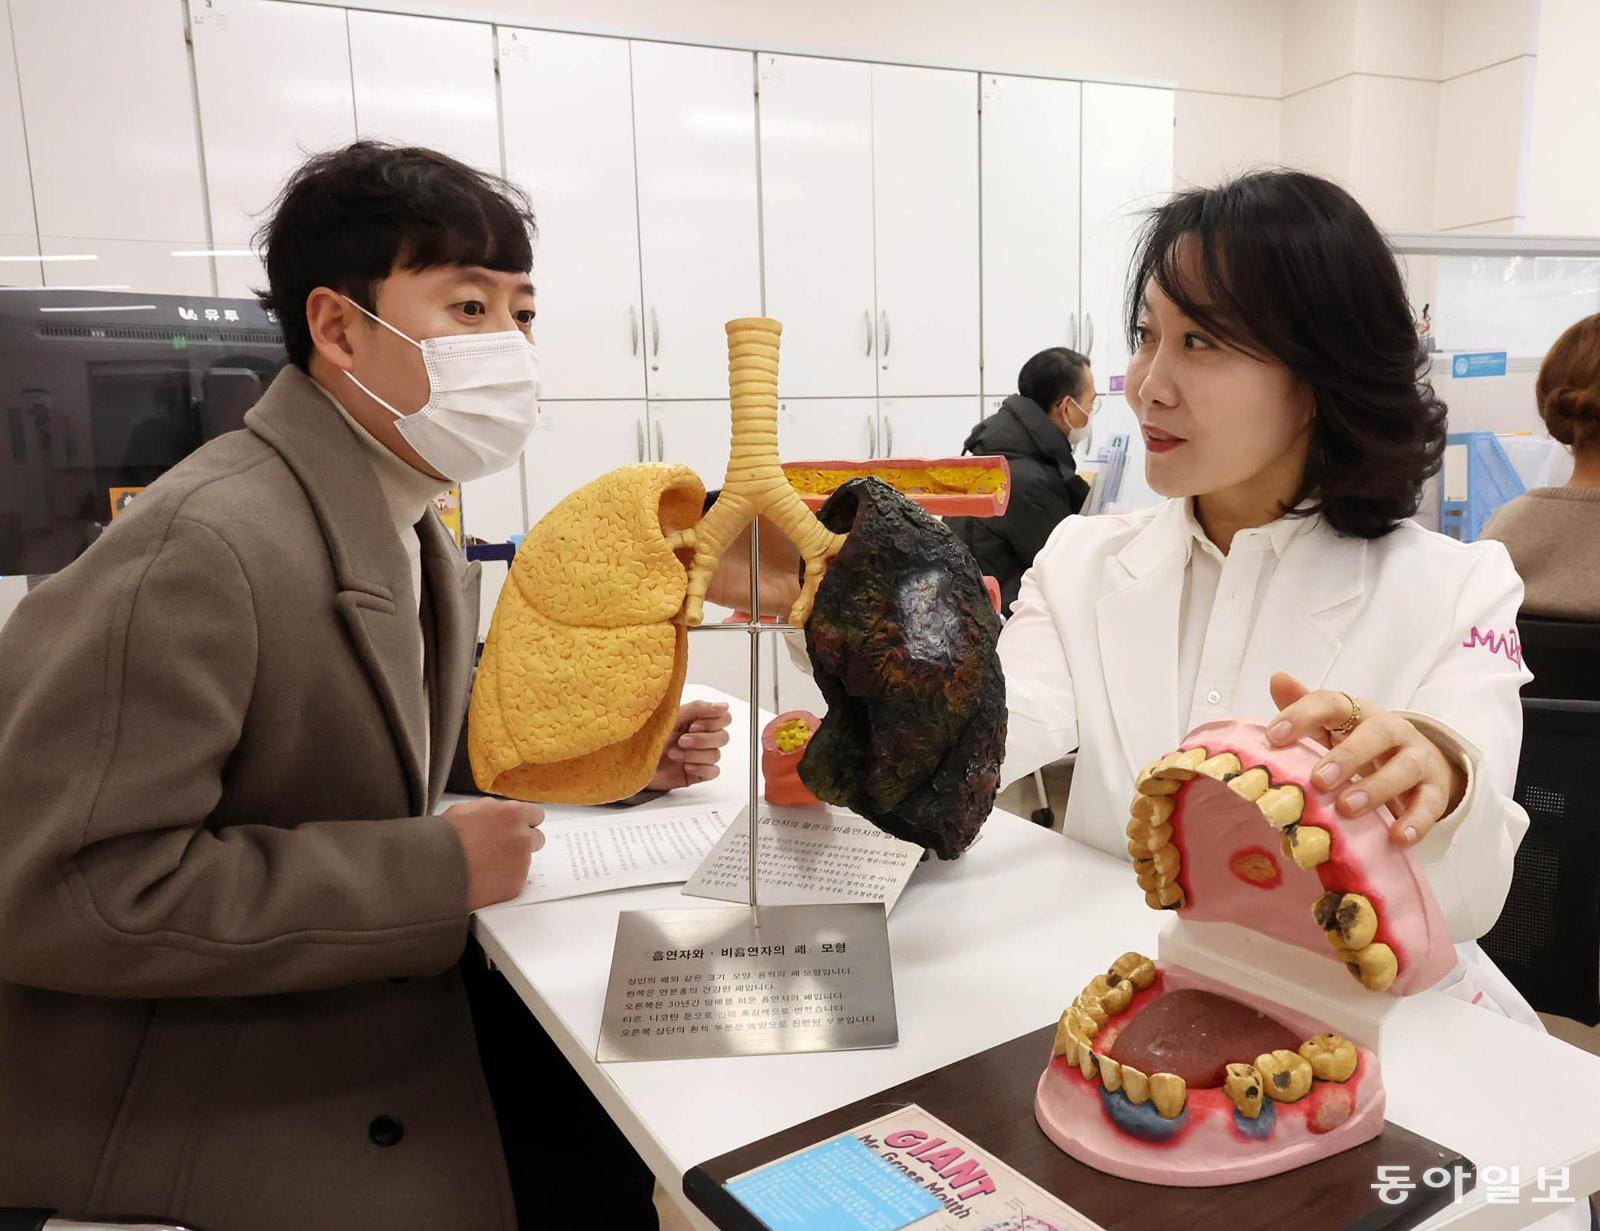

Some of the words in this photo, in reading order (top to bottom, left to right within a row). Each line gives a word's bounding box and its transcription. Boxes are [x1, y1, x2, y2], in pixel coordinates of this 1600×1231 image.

[652, 948, 705, 962] 흡연자와
[720, 945, 785, 959] 비흡연자의
[821, 942, 847, 954] 모형
[667, 1000, 700, 1008] 30년간
[883, 1128, 996, 1201] GIANT
